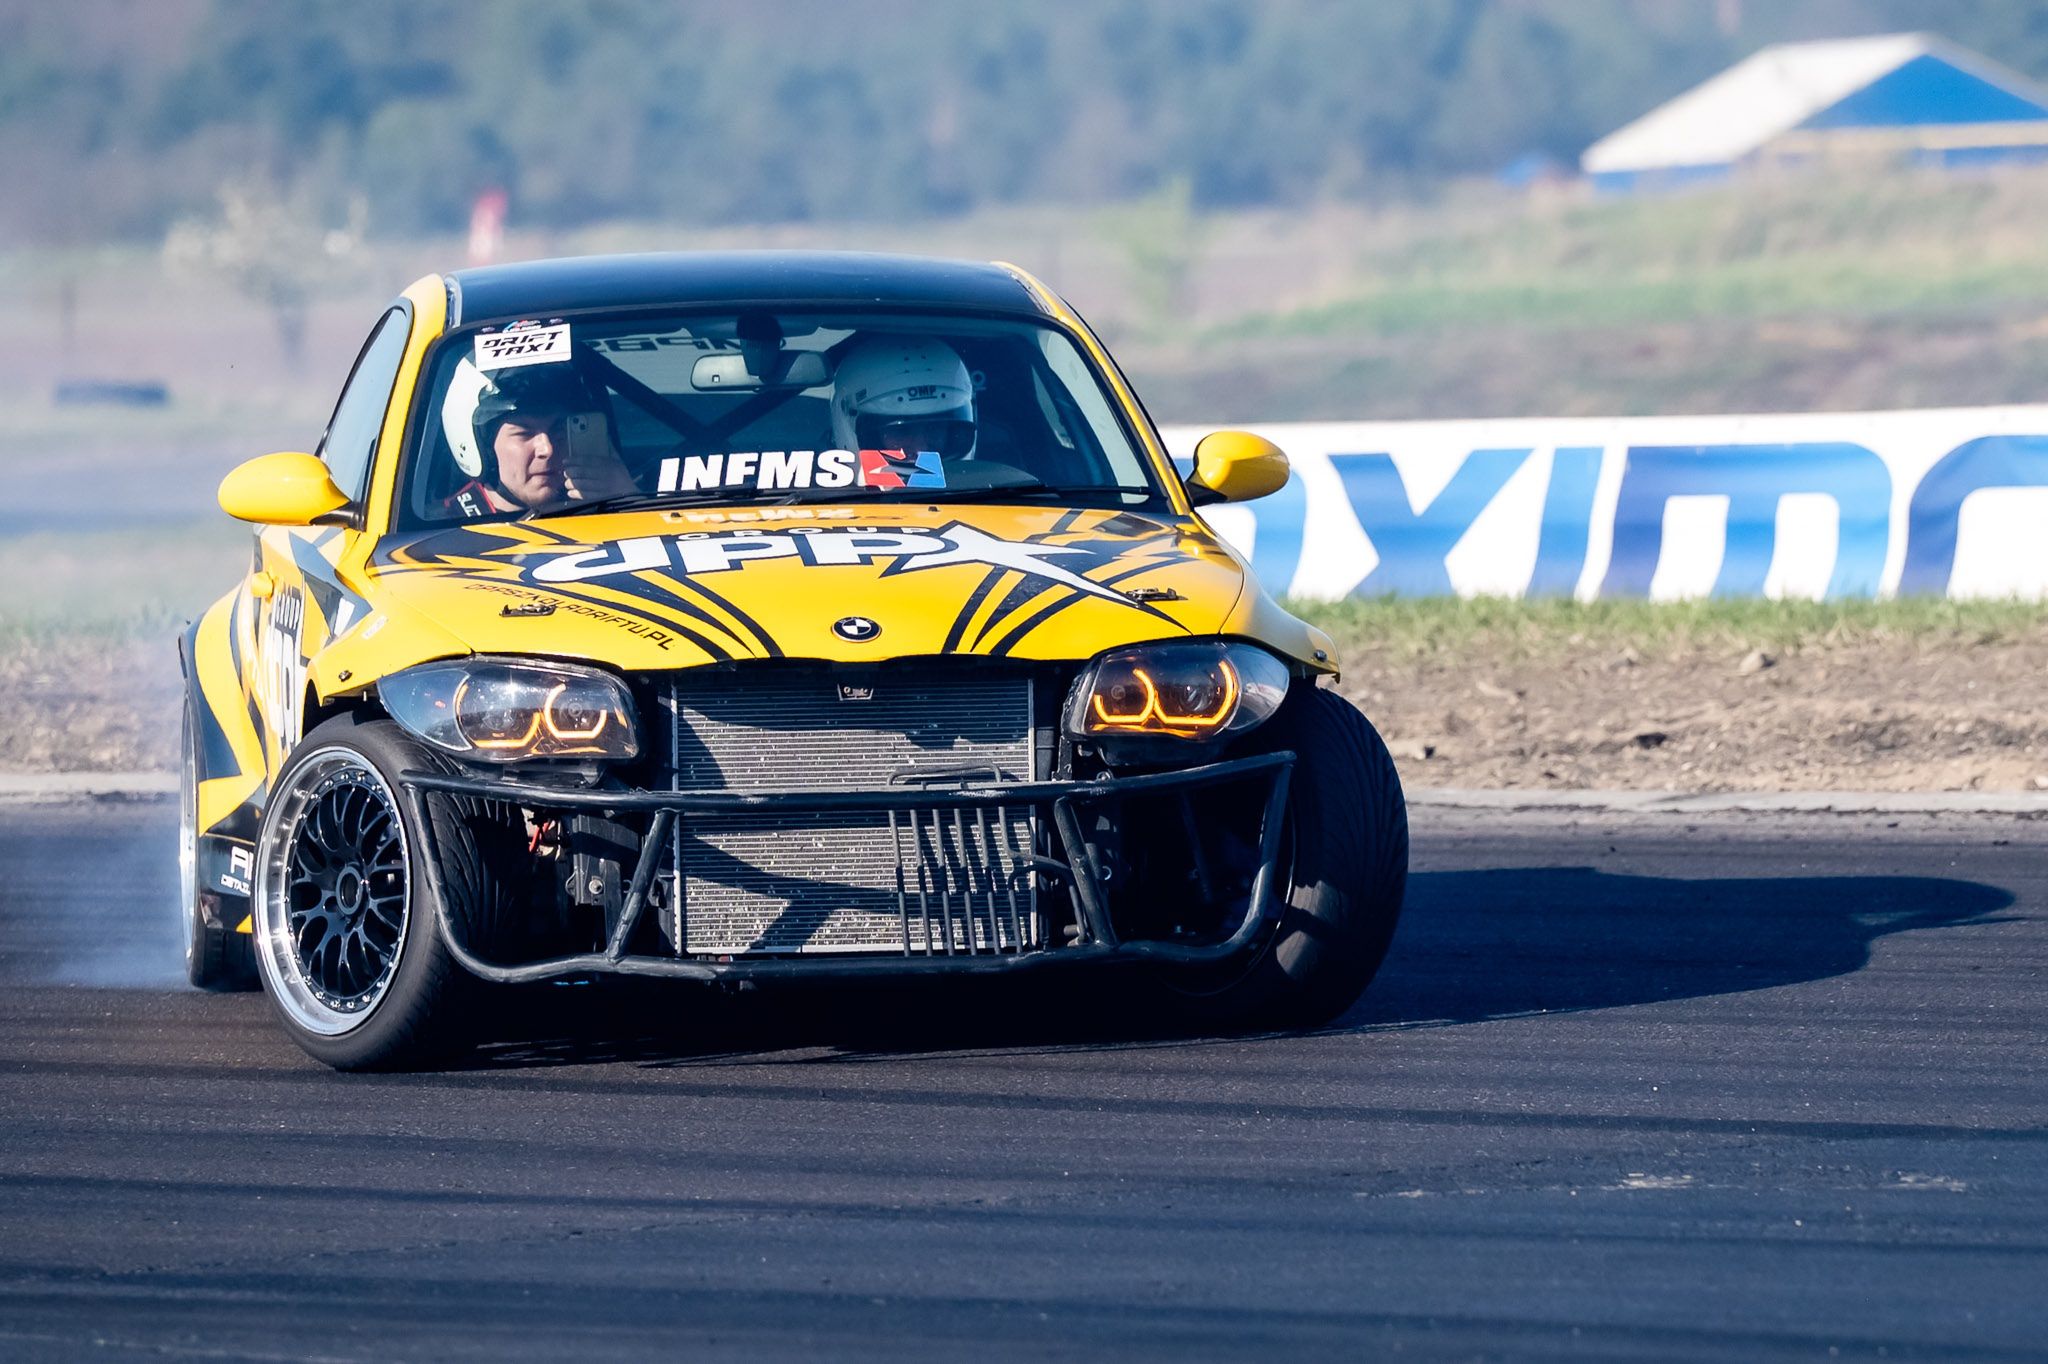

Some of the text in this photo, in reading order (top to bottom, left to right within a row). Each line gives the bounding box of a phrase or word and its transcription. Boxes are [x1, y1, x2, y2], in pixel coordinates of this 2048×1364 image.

[482, 331, 563, 349] DRIFT
[491, 341, 555, 358] TAXI
[908, 385, 937, 397] OMP
[657, 450, 855, 491] INFMS
